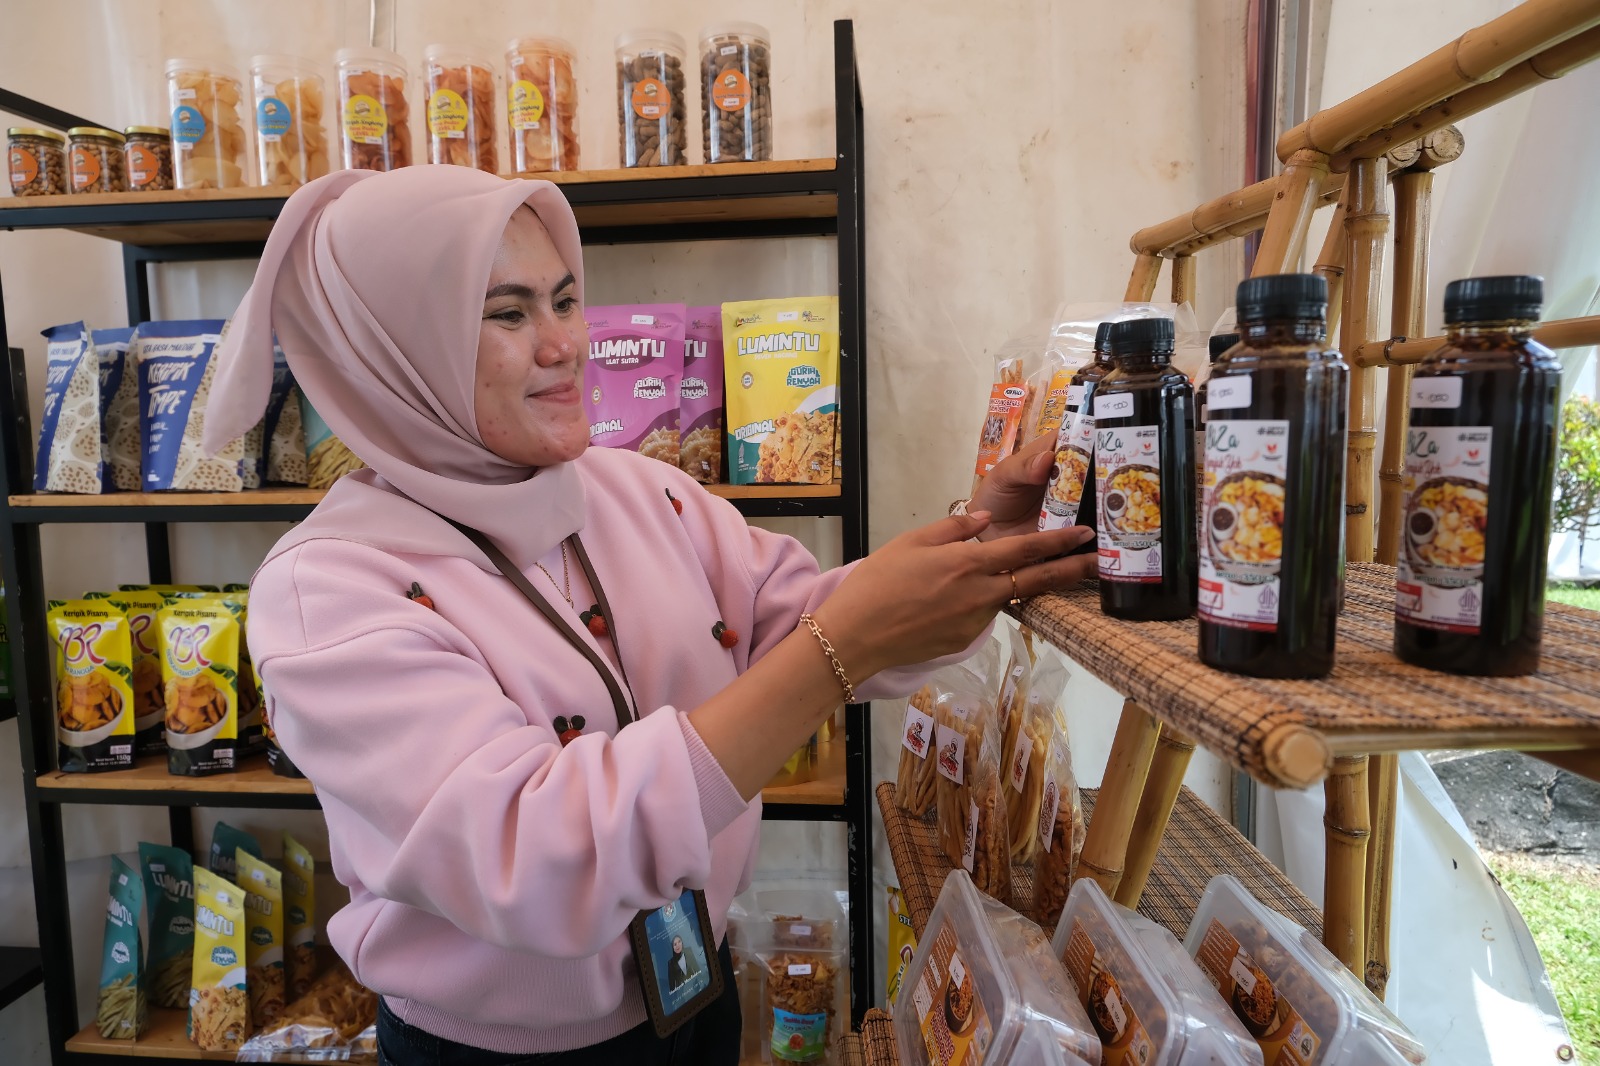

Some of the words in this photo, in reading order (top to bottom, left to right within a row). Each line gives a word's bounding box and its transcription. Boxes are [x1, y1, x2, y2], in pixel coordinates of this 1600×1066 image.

[737, 331, 821, 356] LUMINTU
[588, 338, 666, 360] LUMINTU
[148, 362, 196, 384] KERIPIK
[790, 366, 816, 376] GURIH
[636, 378, 662, 388] GURIH
[786, 377, 821, 386] RENYAH
[633, 388, 666, 399] RENYAH
[734, 418, 776, 441] ORIGINAL
[63, 609, 86, 617] Keripik
[87, 609, 109, 618] Pisang
[196, 609, 217, 618] Pisang
